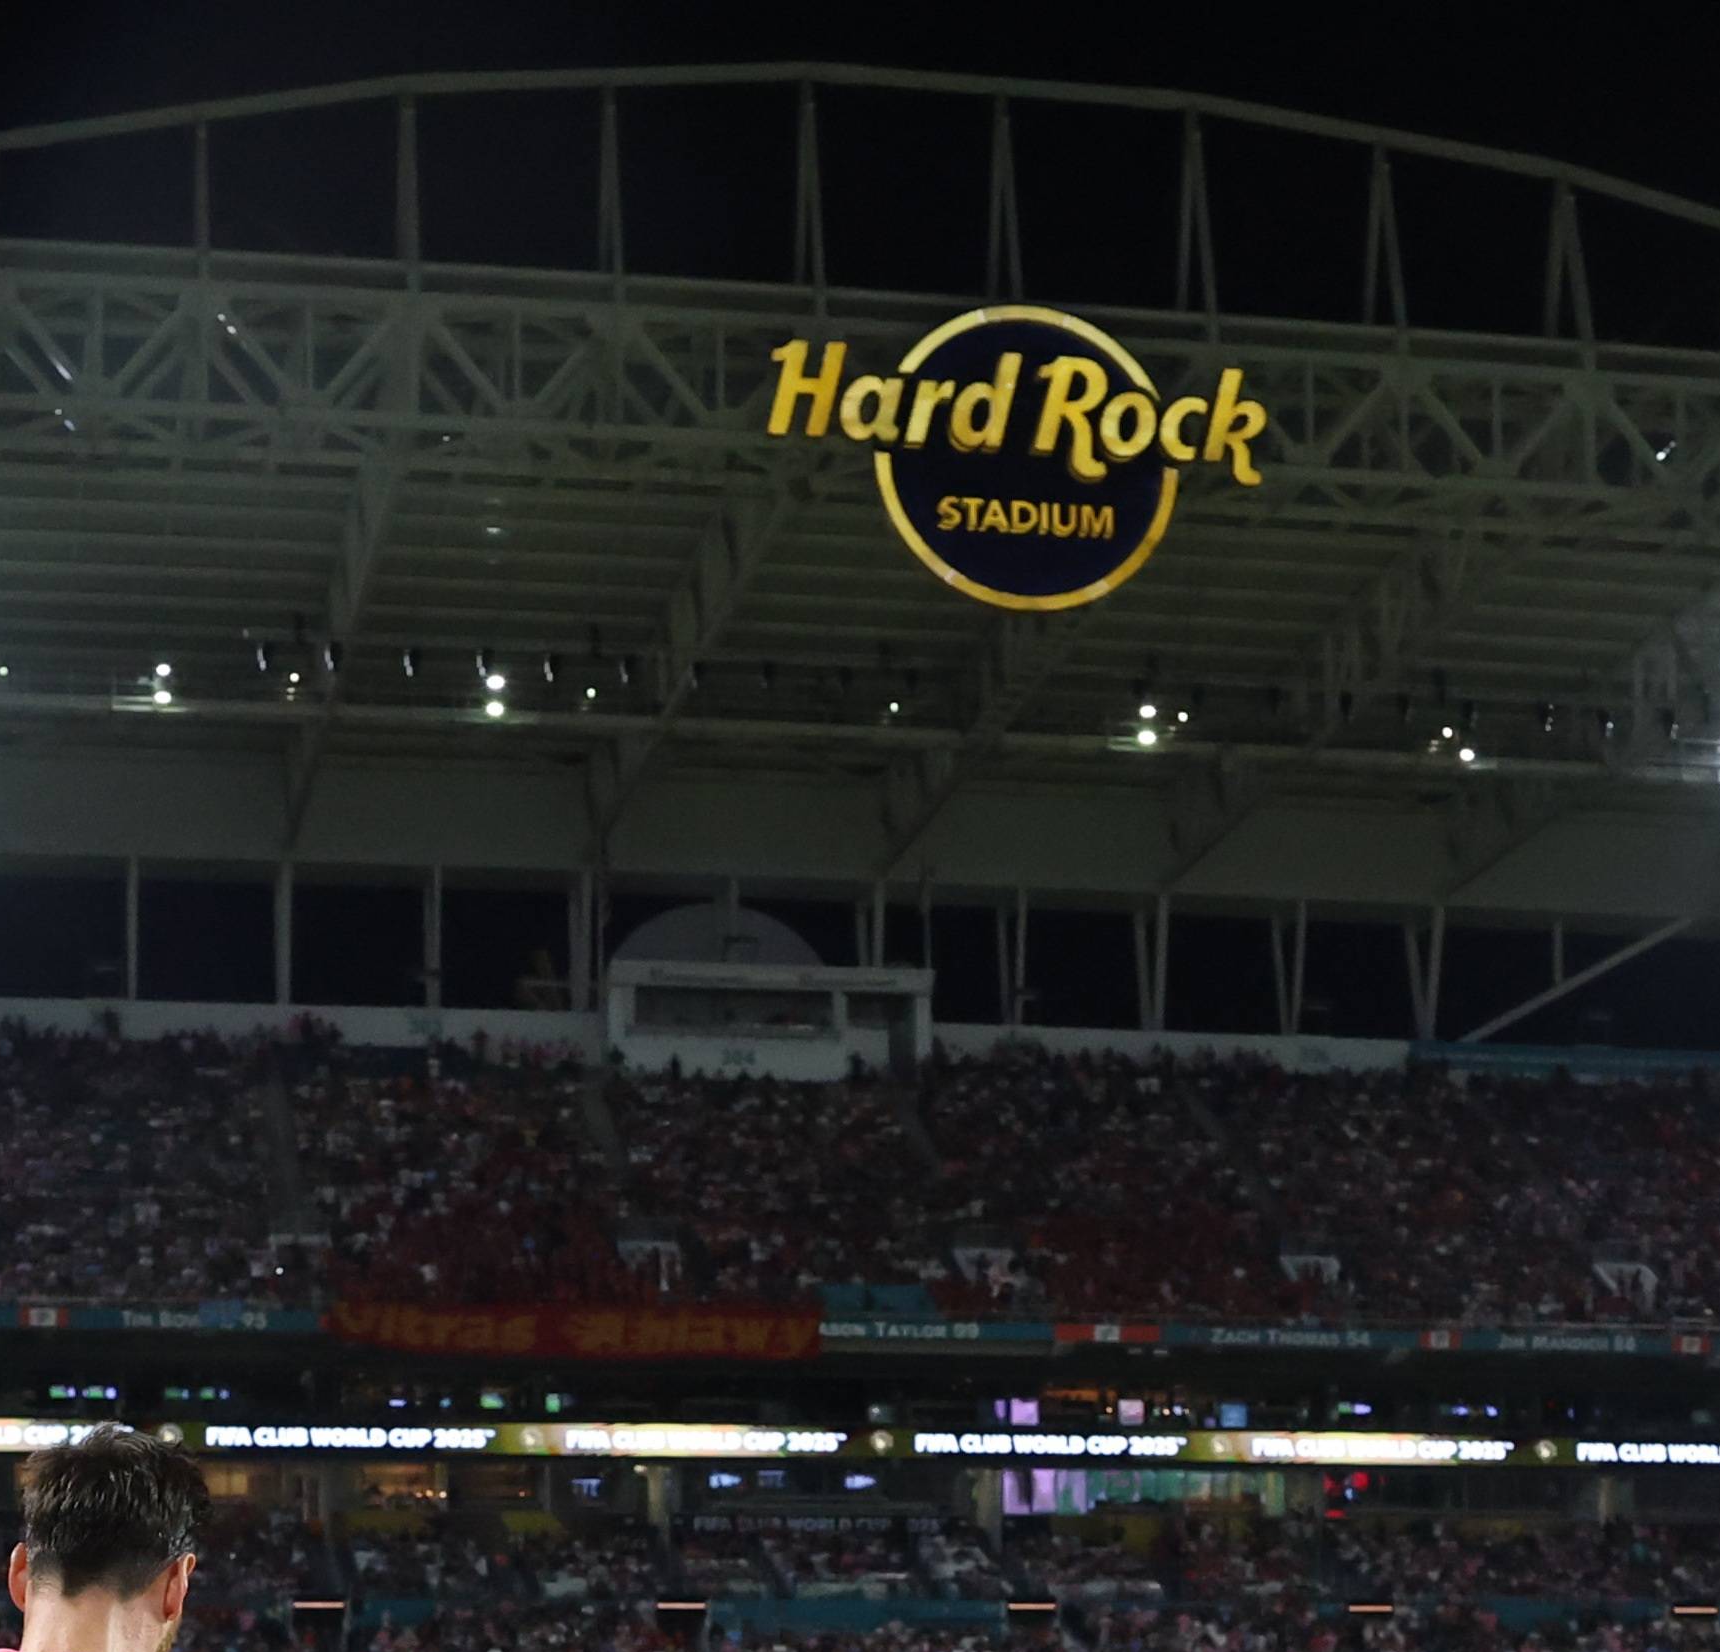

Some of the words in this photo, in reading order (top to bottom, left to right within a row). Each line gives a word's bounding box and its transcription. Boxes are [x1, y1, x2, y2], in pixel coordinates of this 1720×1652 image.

[768, 339, 1023, 453] Hard
[1033, 355, 1268, 487] Rock
[936, 496, 1115, 540] STADIUM
[818, 1322, 867, 1338] ASON
[205, 1427, 252, 1446] FIFA
[253, 1427, 309, 1446] CLUB
[310, 1428, 387, 1447] WORLD
[388, 1428, 432, 1447] CUP
[1087, 1436, 1128, 1454] CUP
